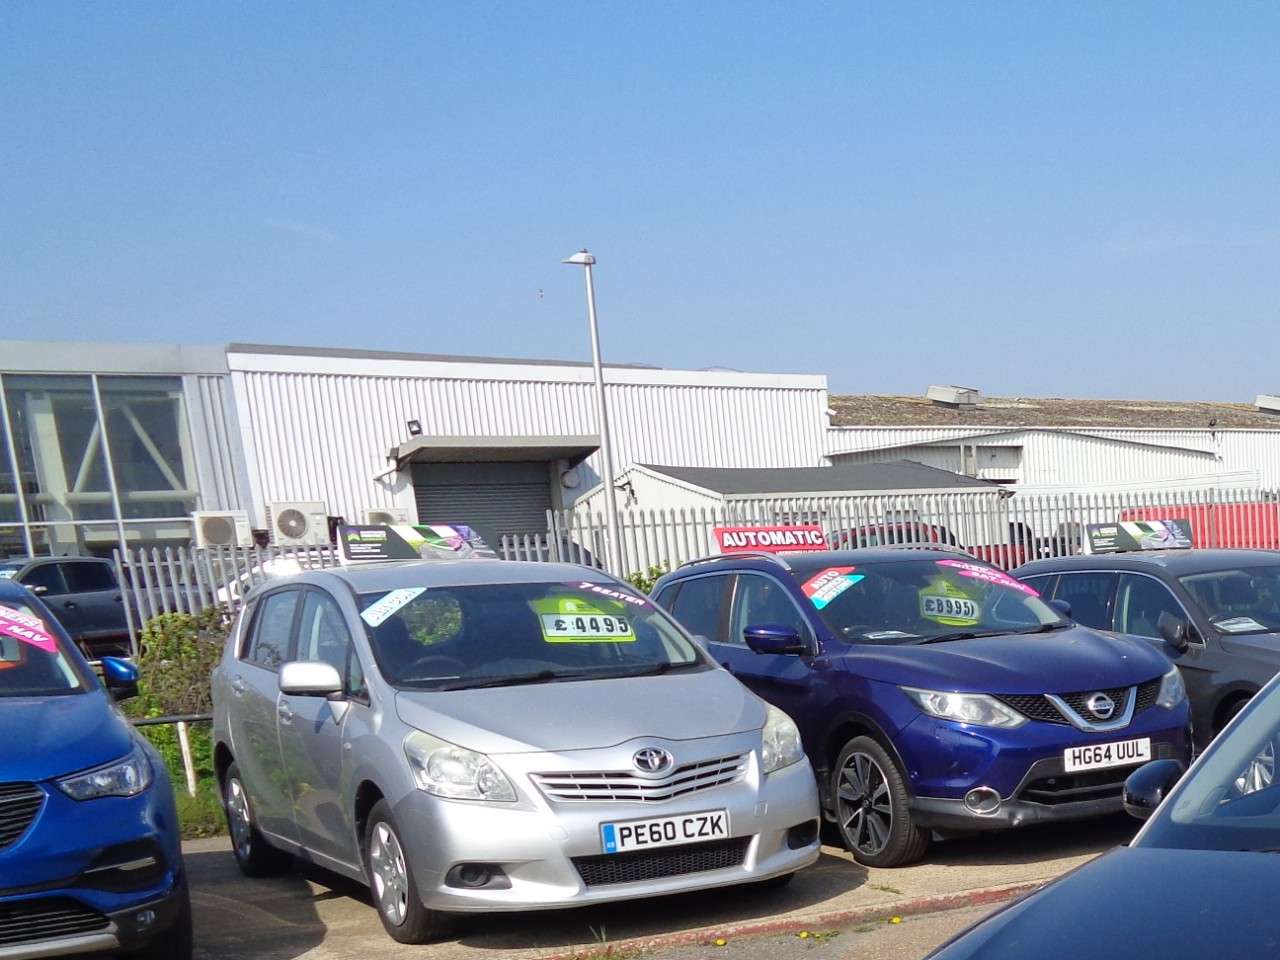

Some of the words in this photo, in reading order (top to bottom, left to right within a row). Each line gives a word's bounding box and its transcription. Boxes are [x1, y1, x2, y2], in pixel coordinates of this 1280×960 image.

[723, 531, 823, 547] AUTOMATIC
[811, 569, 840, 590] AUTO
[592, 586, 646, 606] SEATER
[7, 625, 48, 641] NAV
[1072, 745, 1112, 766] HG64
[1117, 741, 1144, 760] UUL
[619, 821, 676, 847] PE60
[682, 815, 723, 838] CZK
